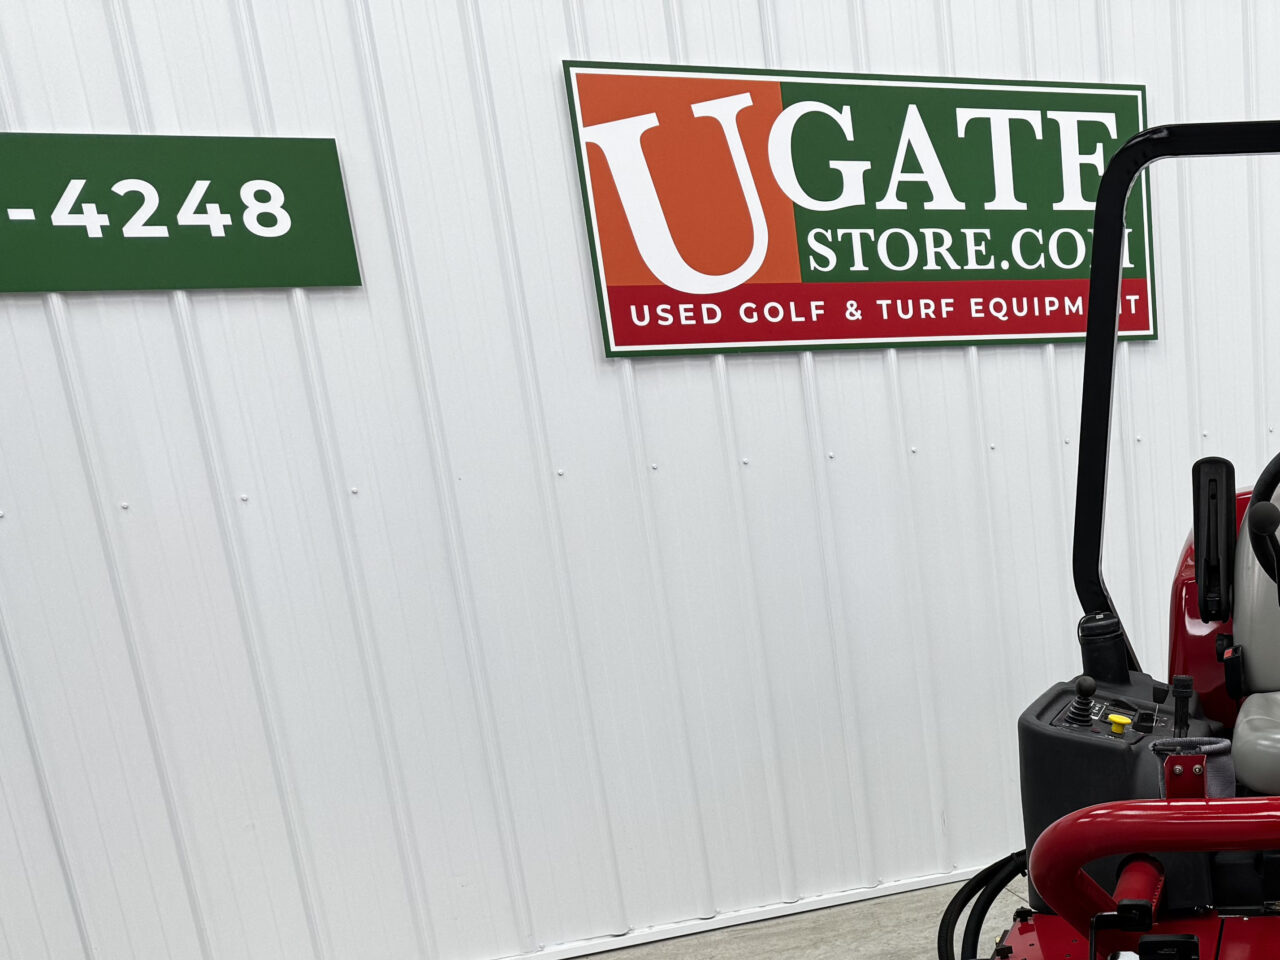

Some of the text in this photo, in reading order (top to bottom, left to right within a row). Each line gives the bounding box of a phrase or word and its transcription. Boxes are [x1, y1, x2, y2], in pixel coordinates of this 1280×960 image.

[630, 295, 1140, 327] USED GOLF & TURF EQUIPMT
